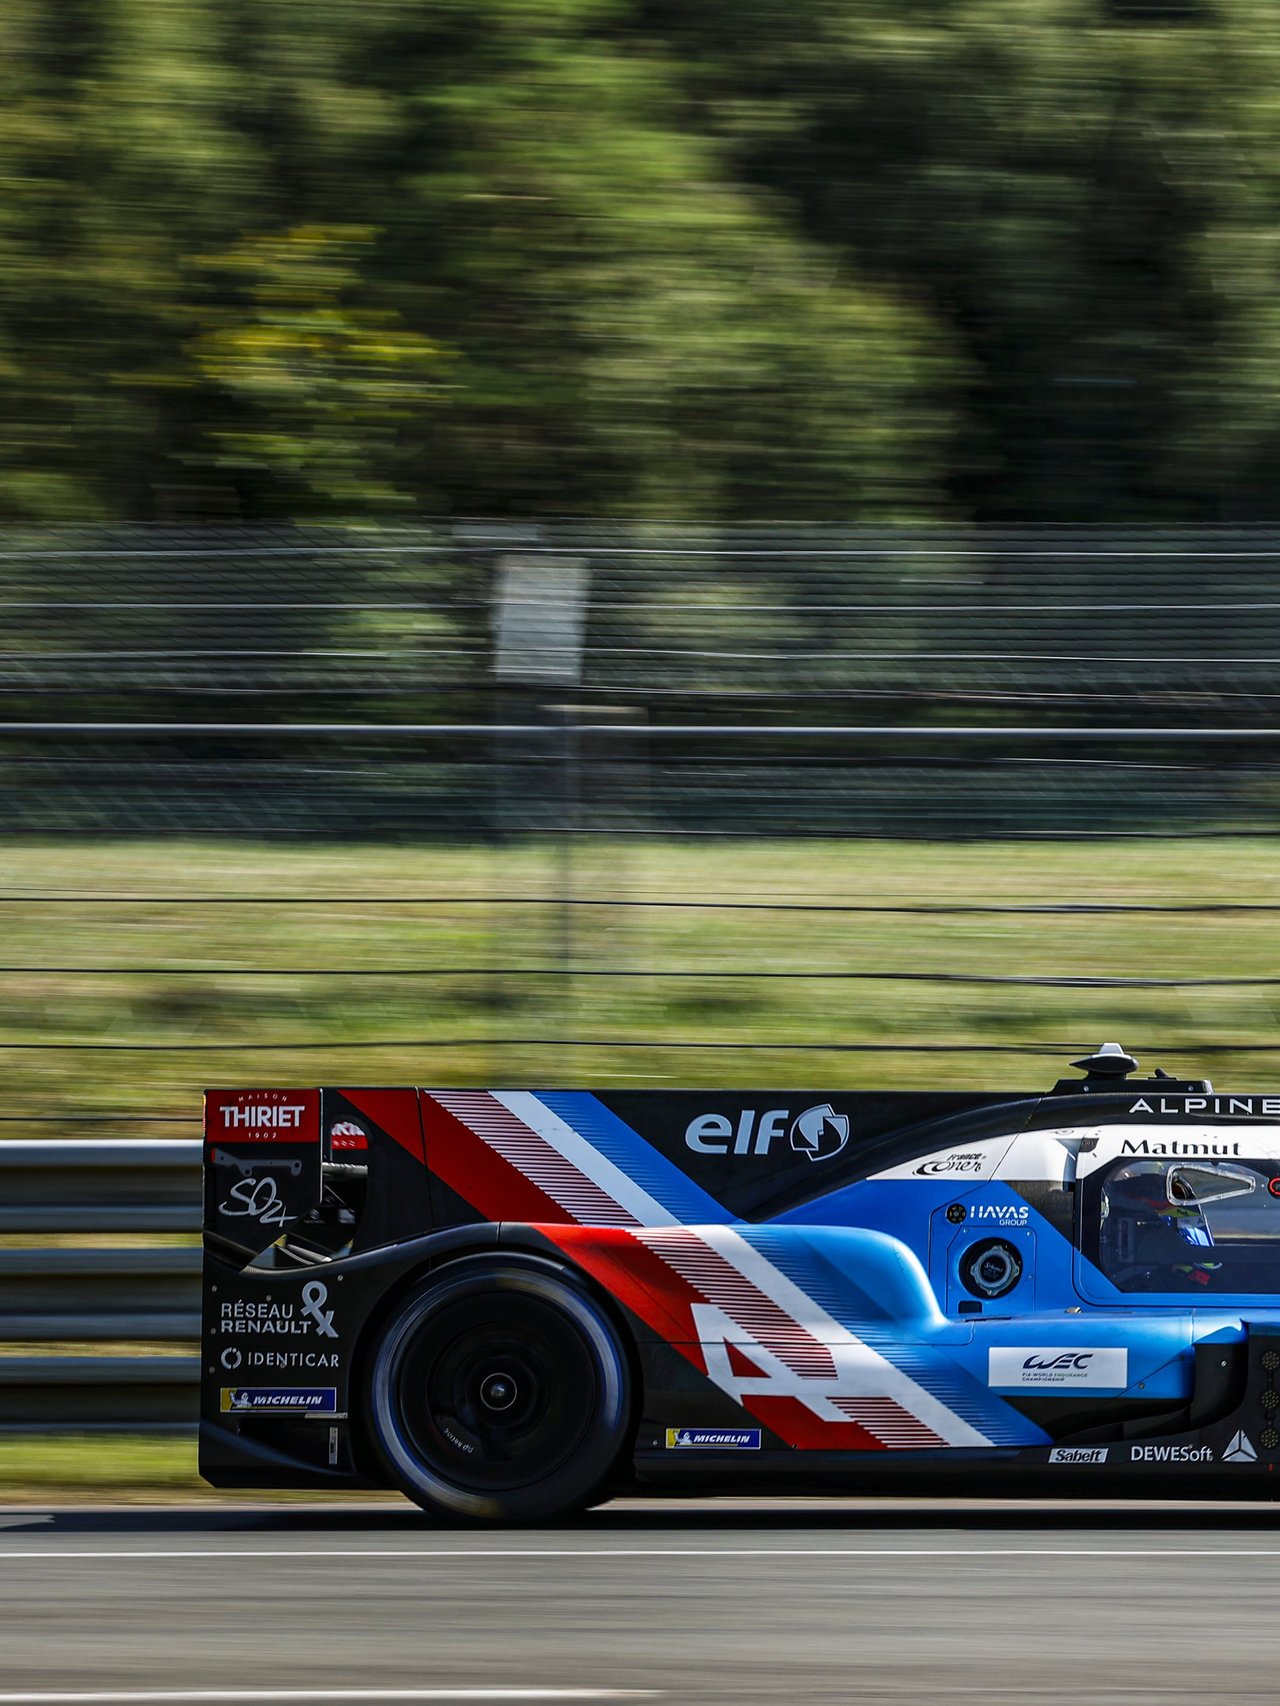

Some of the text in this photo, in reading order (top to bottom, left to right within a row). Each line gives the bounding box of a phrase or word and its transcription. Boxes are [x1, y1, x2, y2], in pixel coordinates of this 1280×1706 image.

[238, 1093, 288, 1102] MAISON
[219, 1105, 305, 1128] THIRIET
[684, 1109, 790, 1155] elf
[1120, 1139, 1243, 1157] Matmut
[970, 1205, 1029, 1219] HAVAS
[999, 1219, 1028, 1227] GROUP
[221, 1299, 294, 1319] RÉSEAU
[221, 1320, 312, 1334] RENAULT
[248, 1352, 340, 1368] IDENTICAR
[1022, 1352, 1094, 1370] WEC
[252, 1395, 323, 1405] MICHELIN
[693, 1434, 751, 1444] MICHELIN
[1054, 1448, 1103, 1463] Sabelt
